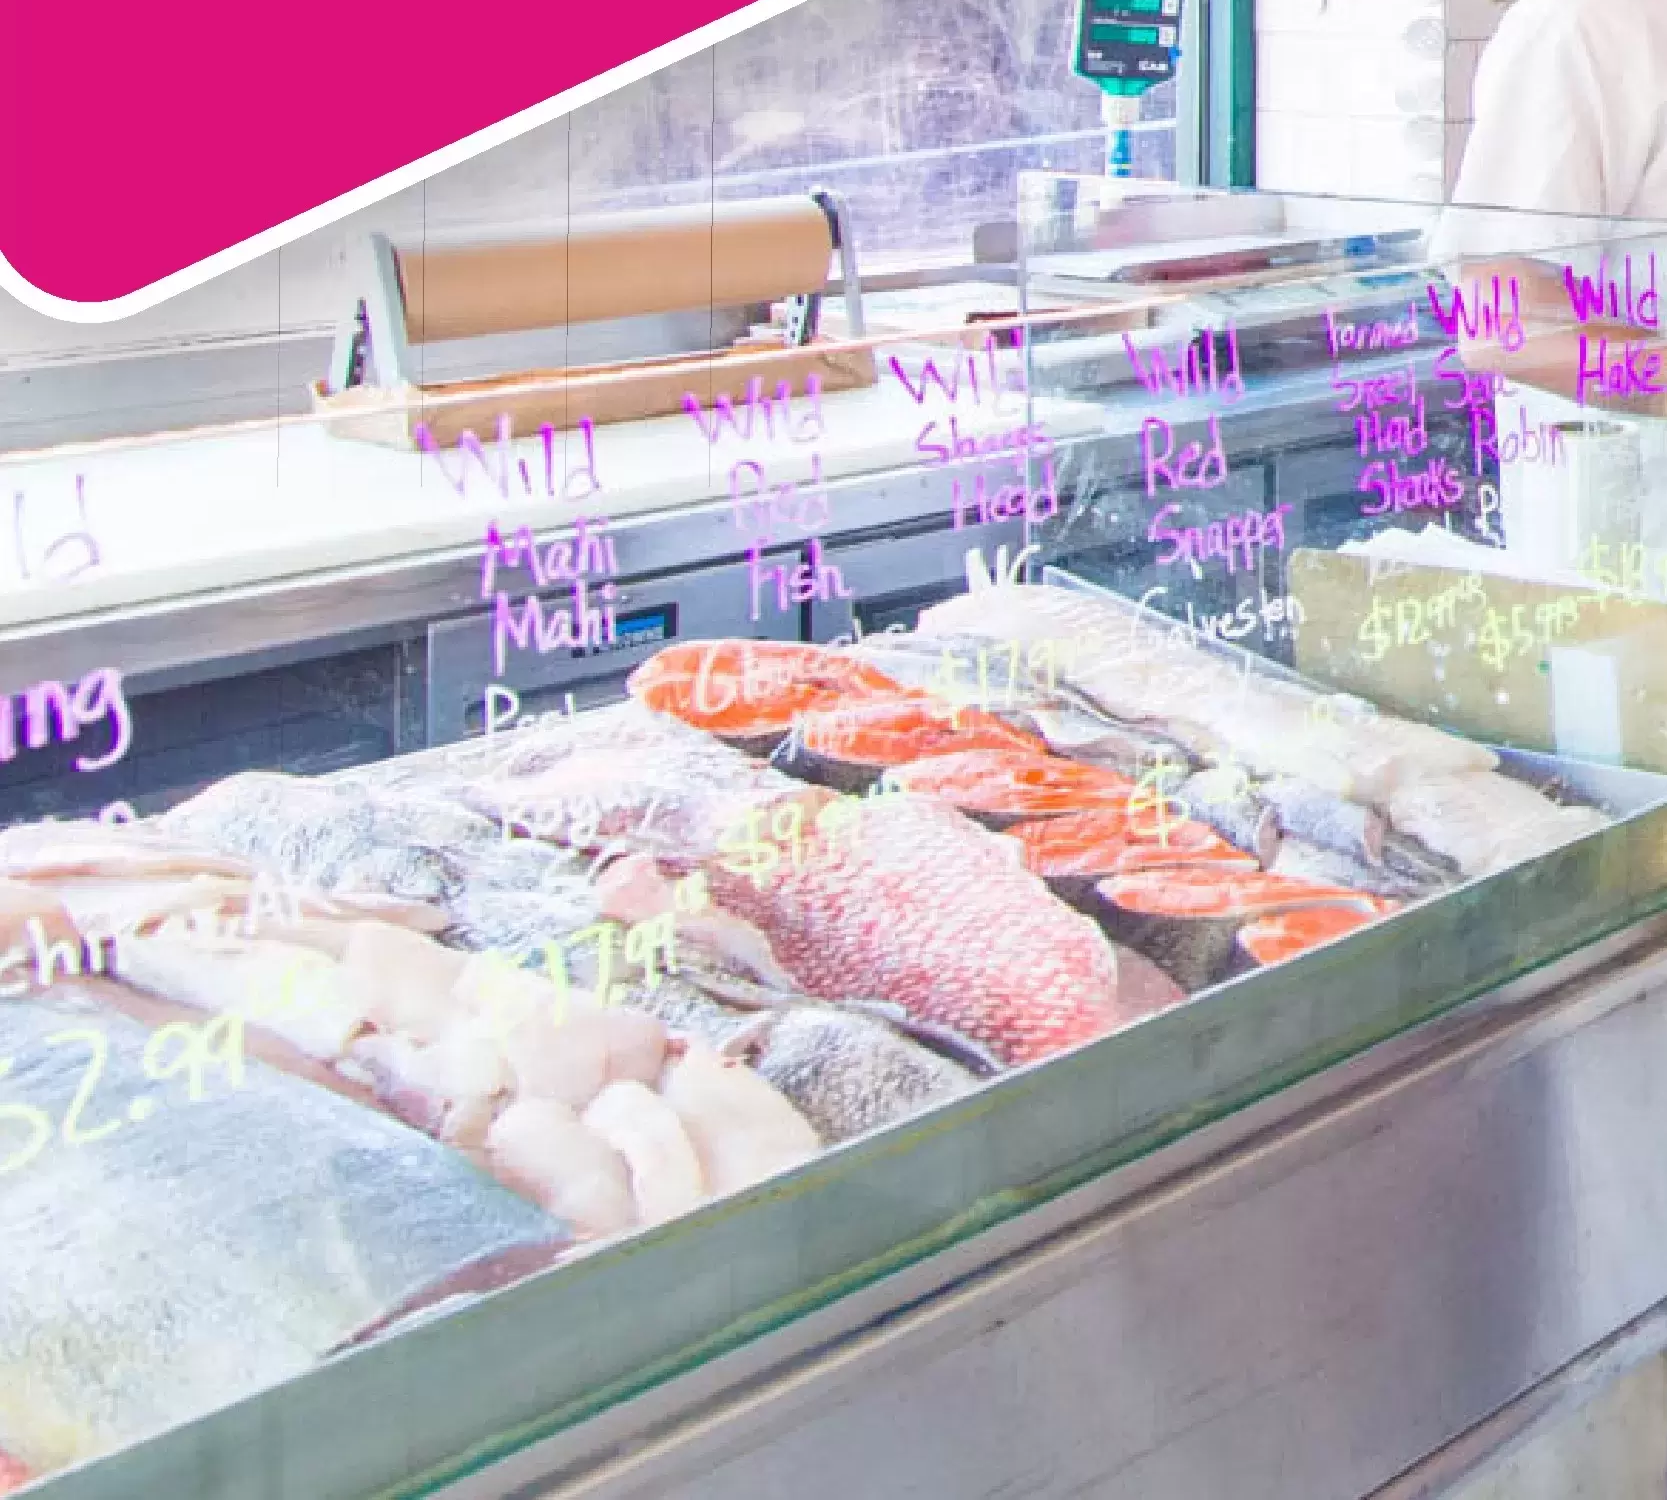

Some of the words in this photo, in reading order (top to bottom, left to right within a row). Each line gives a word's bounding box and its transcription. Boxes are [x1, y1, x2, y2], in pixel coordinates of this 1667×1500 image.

[1426, 274, 1526, 352] Wild
[1563, 251, 1661, 326] Wild
[1122, 320, 1246, 404] Wild
[681, 375, 825, 445] Wild
[414, 412, 602, 498] Wild
[1140, 411, 1228, 500] Red
[480, 517, 617, 599] Mahi
[489, 580, 618, 677] Mahi
